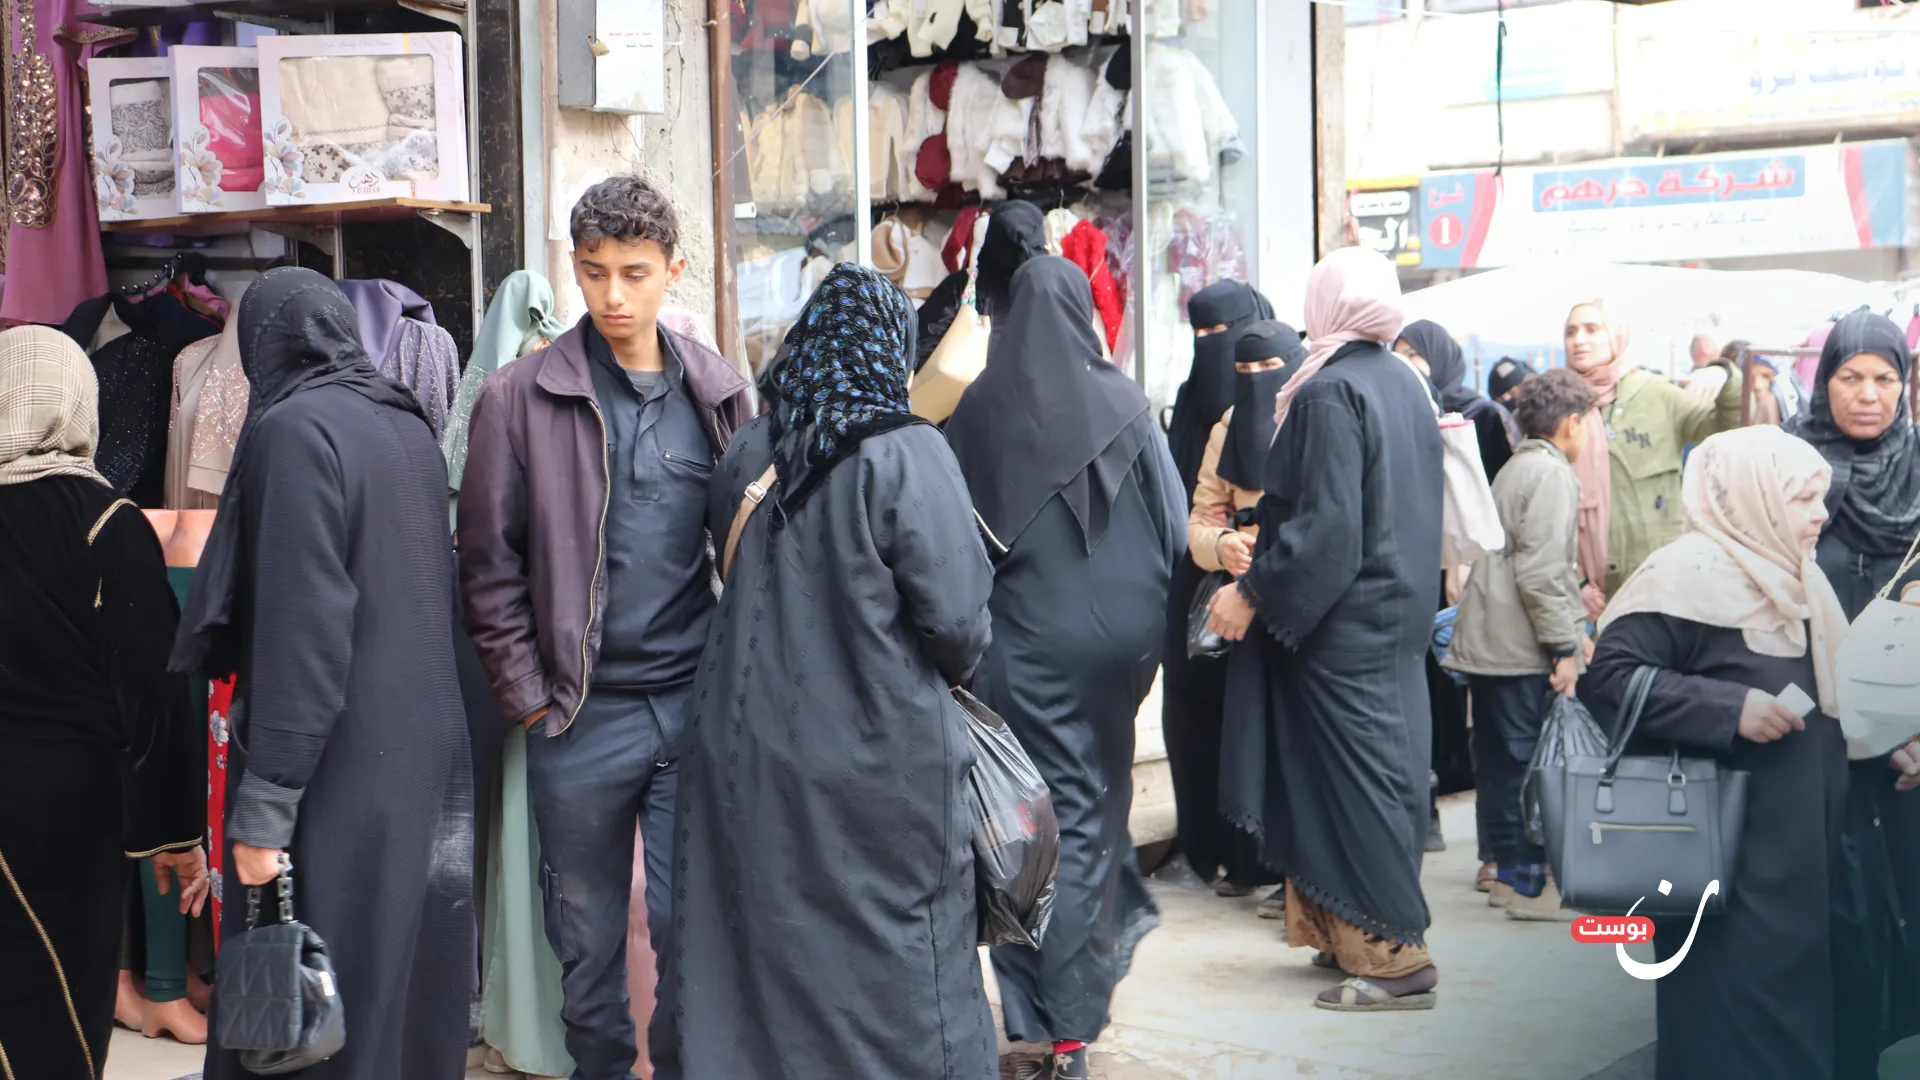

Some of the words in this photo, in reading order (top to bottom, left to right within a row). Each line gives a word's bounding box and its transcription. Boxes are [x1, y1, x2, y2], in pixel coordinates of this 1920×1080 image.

[1541, 177, 1649, 208] درهم
[1655, 158, 1794, 198] شركة
[1440, 217, 1451, 245] 1
